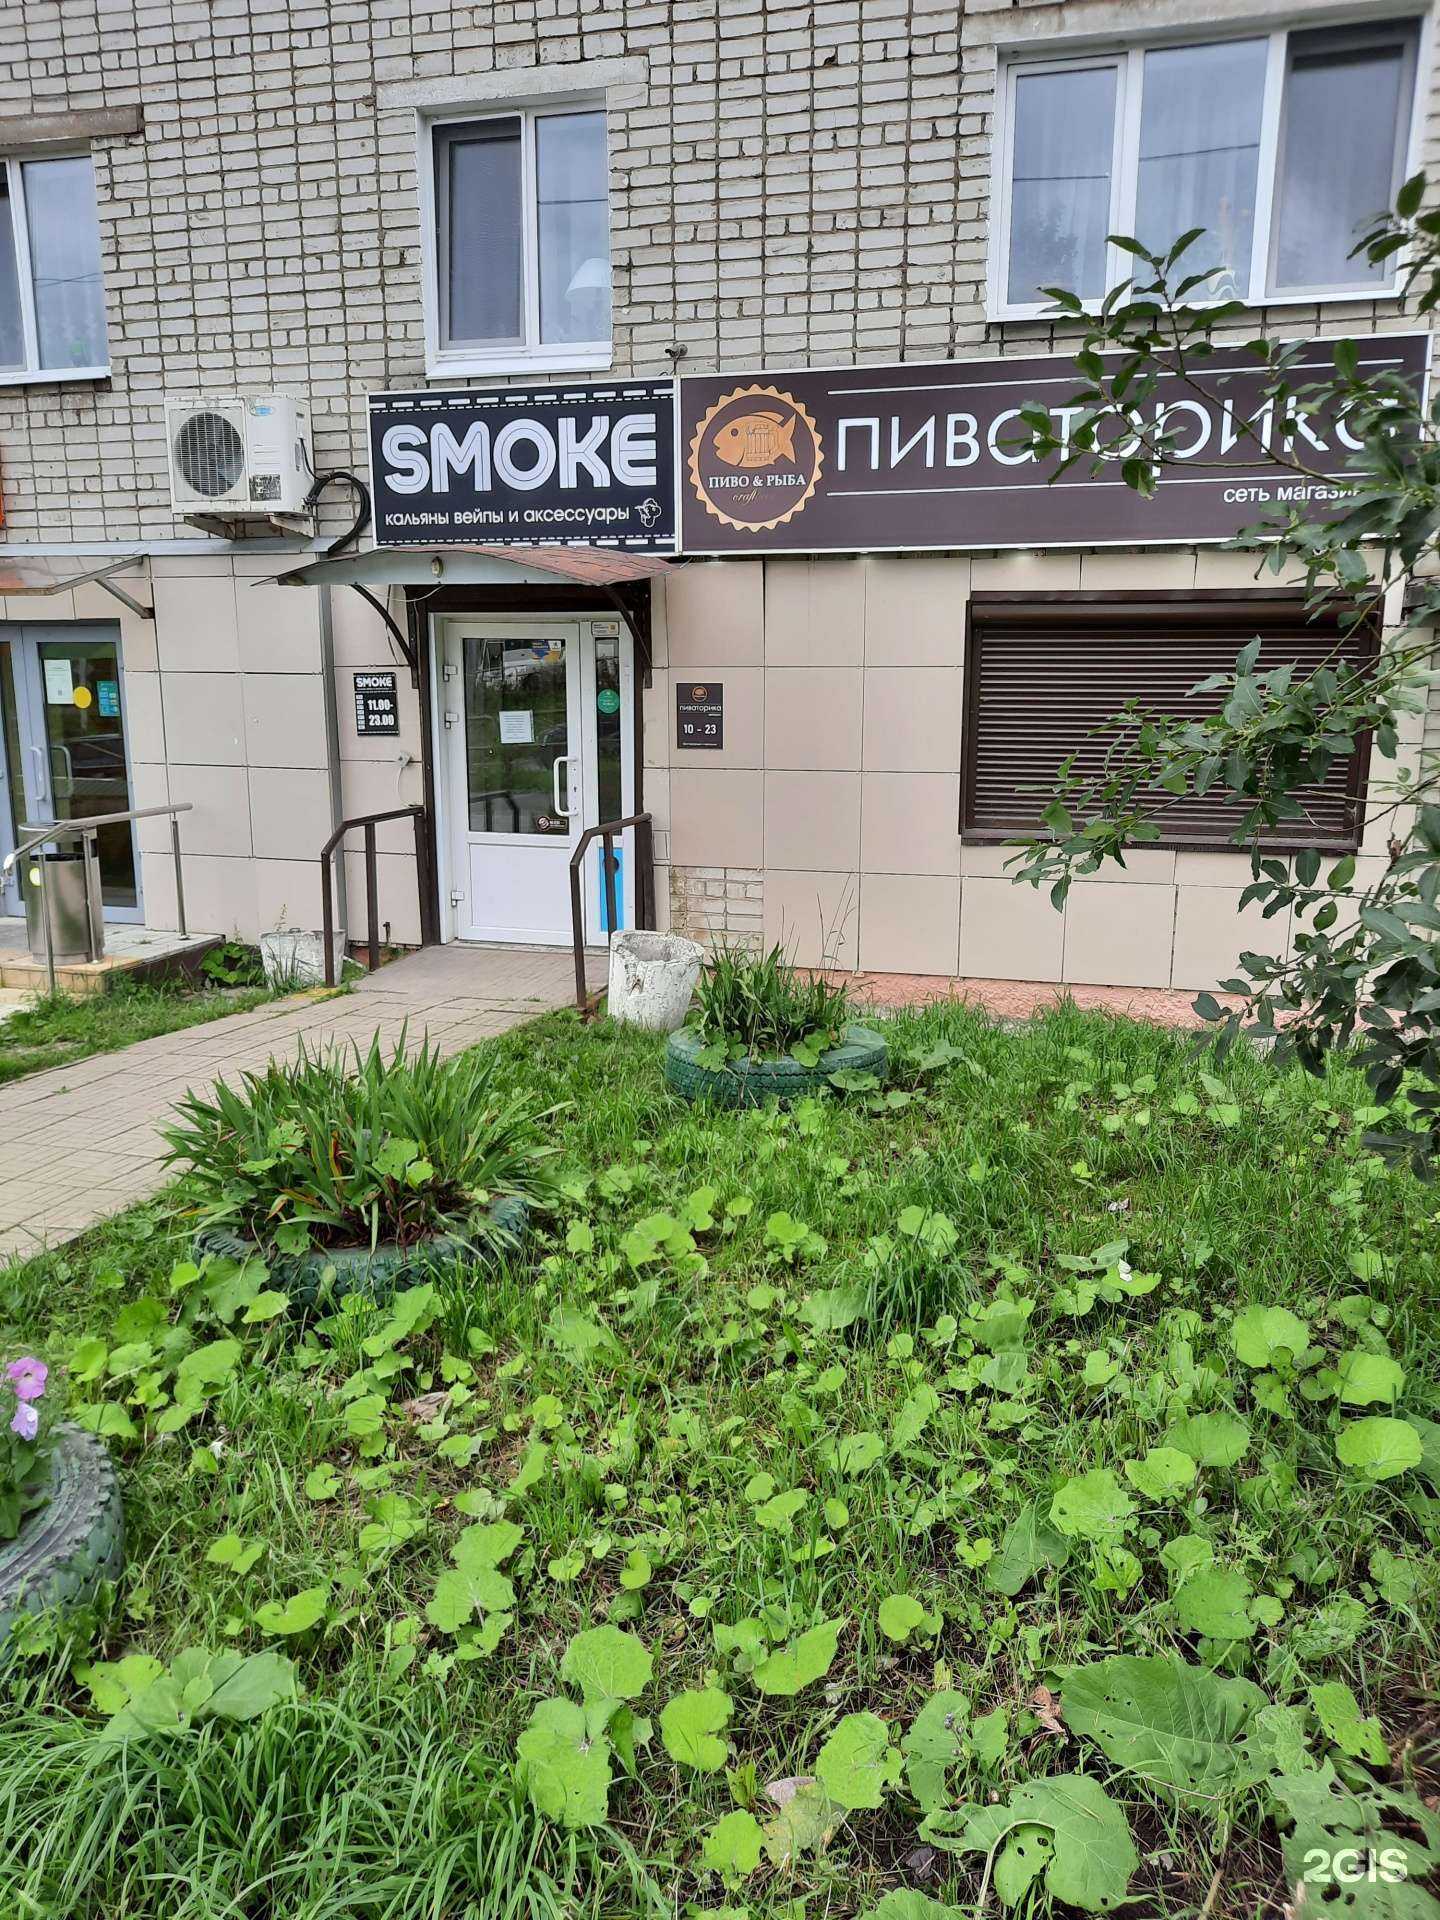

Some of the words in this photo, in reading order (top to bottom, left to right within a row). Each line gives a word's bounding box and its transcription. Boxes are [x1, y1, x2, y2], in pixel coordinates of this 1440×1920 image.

[381, 413, 656, 494] SMOKE
[709, 476, 749, 489] ПИВО
[753, 476, 763, 487] &
[767, 474, 806, 487] РЫБА
[1223, 488, 1270, 503] сеть
[385, 511, 449, 526] кальяны
[454, 508, 504, 525] вейпы
[509, 510, 519, 523] и
[524, 506, 629, 529] аксессуары
[356, 677, 392, 687] SMOKE
[368, 714, 395, 726] 23.00
[683, 724, 694, 734] 10
[705, 724, 716, 734] 23
